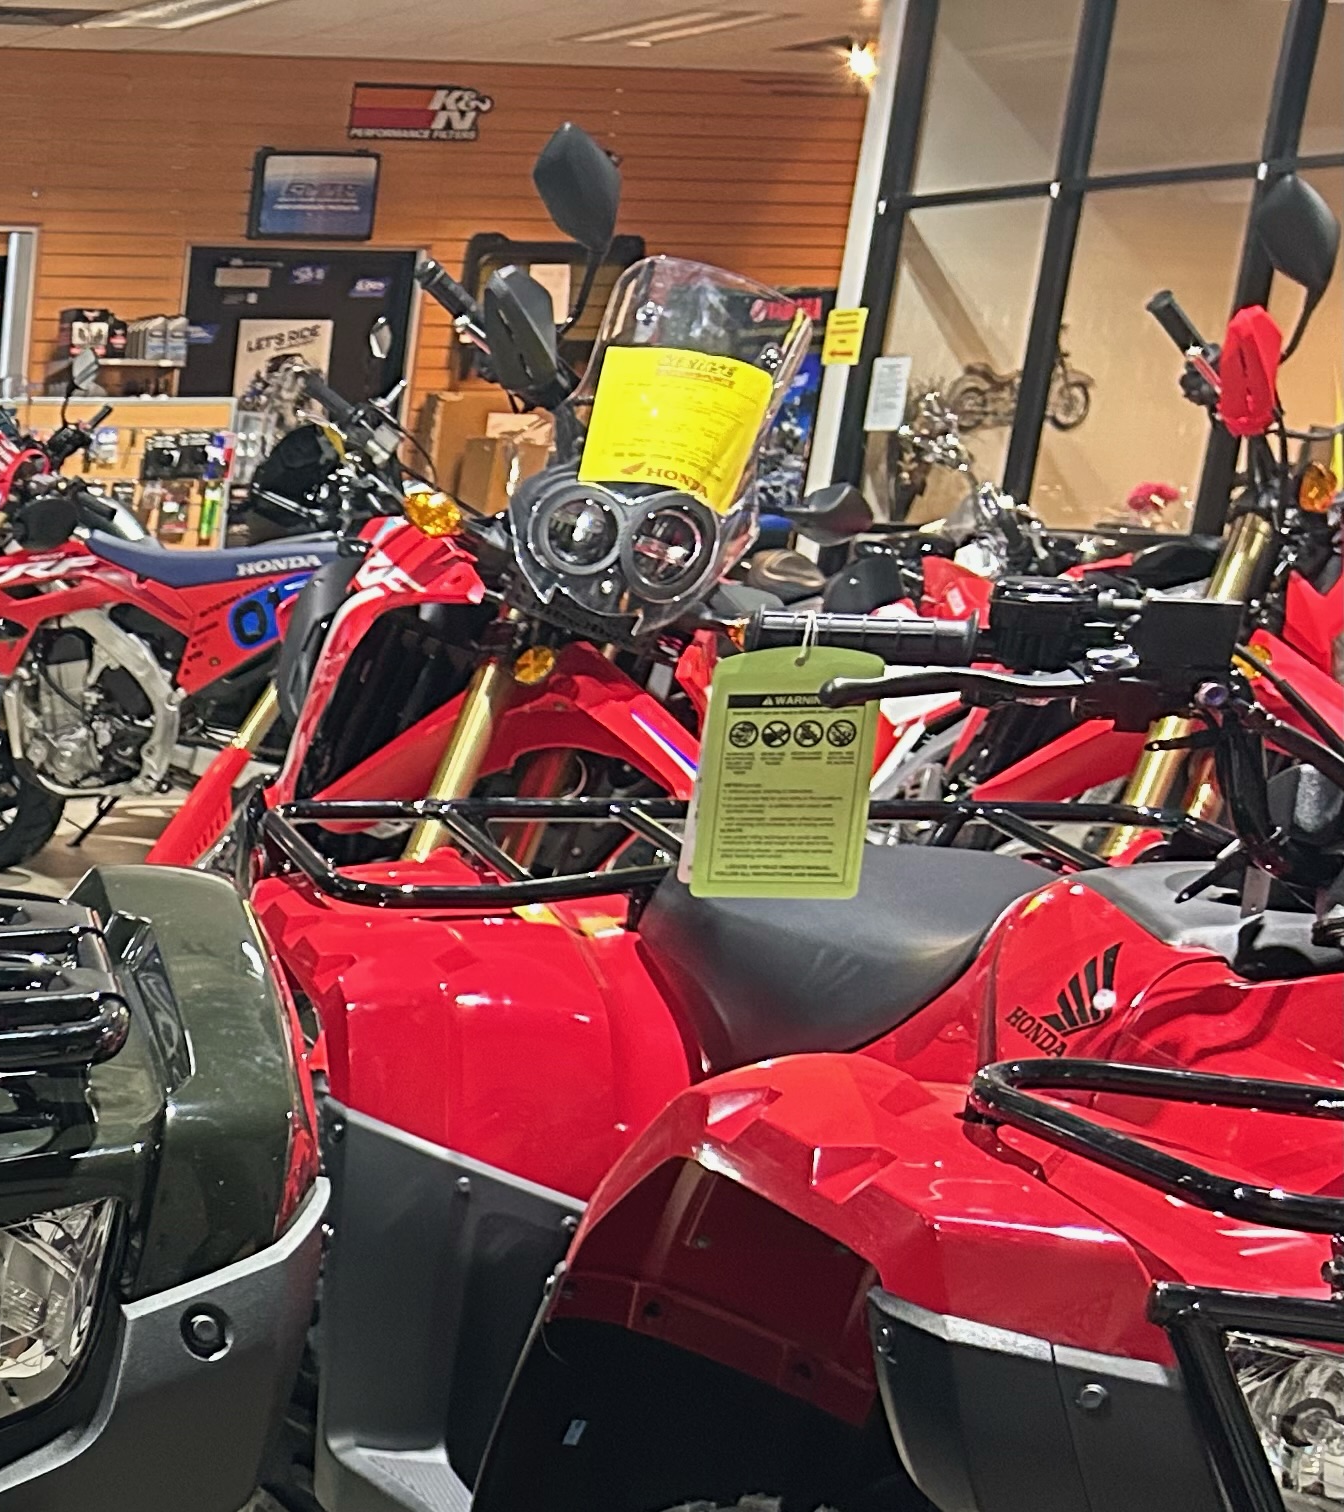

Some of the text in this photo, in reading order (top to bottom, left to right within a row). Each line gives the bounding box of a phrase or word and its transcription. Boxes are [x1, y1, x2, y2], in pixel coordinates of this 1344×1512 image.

[645, 466, 709, 500] HONDA
[235, 554, 322, 577] HONDA
[774, 695, 822, 706] WARNIN
[1004, 1004, 1069, 1059] HONDA
